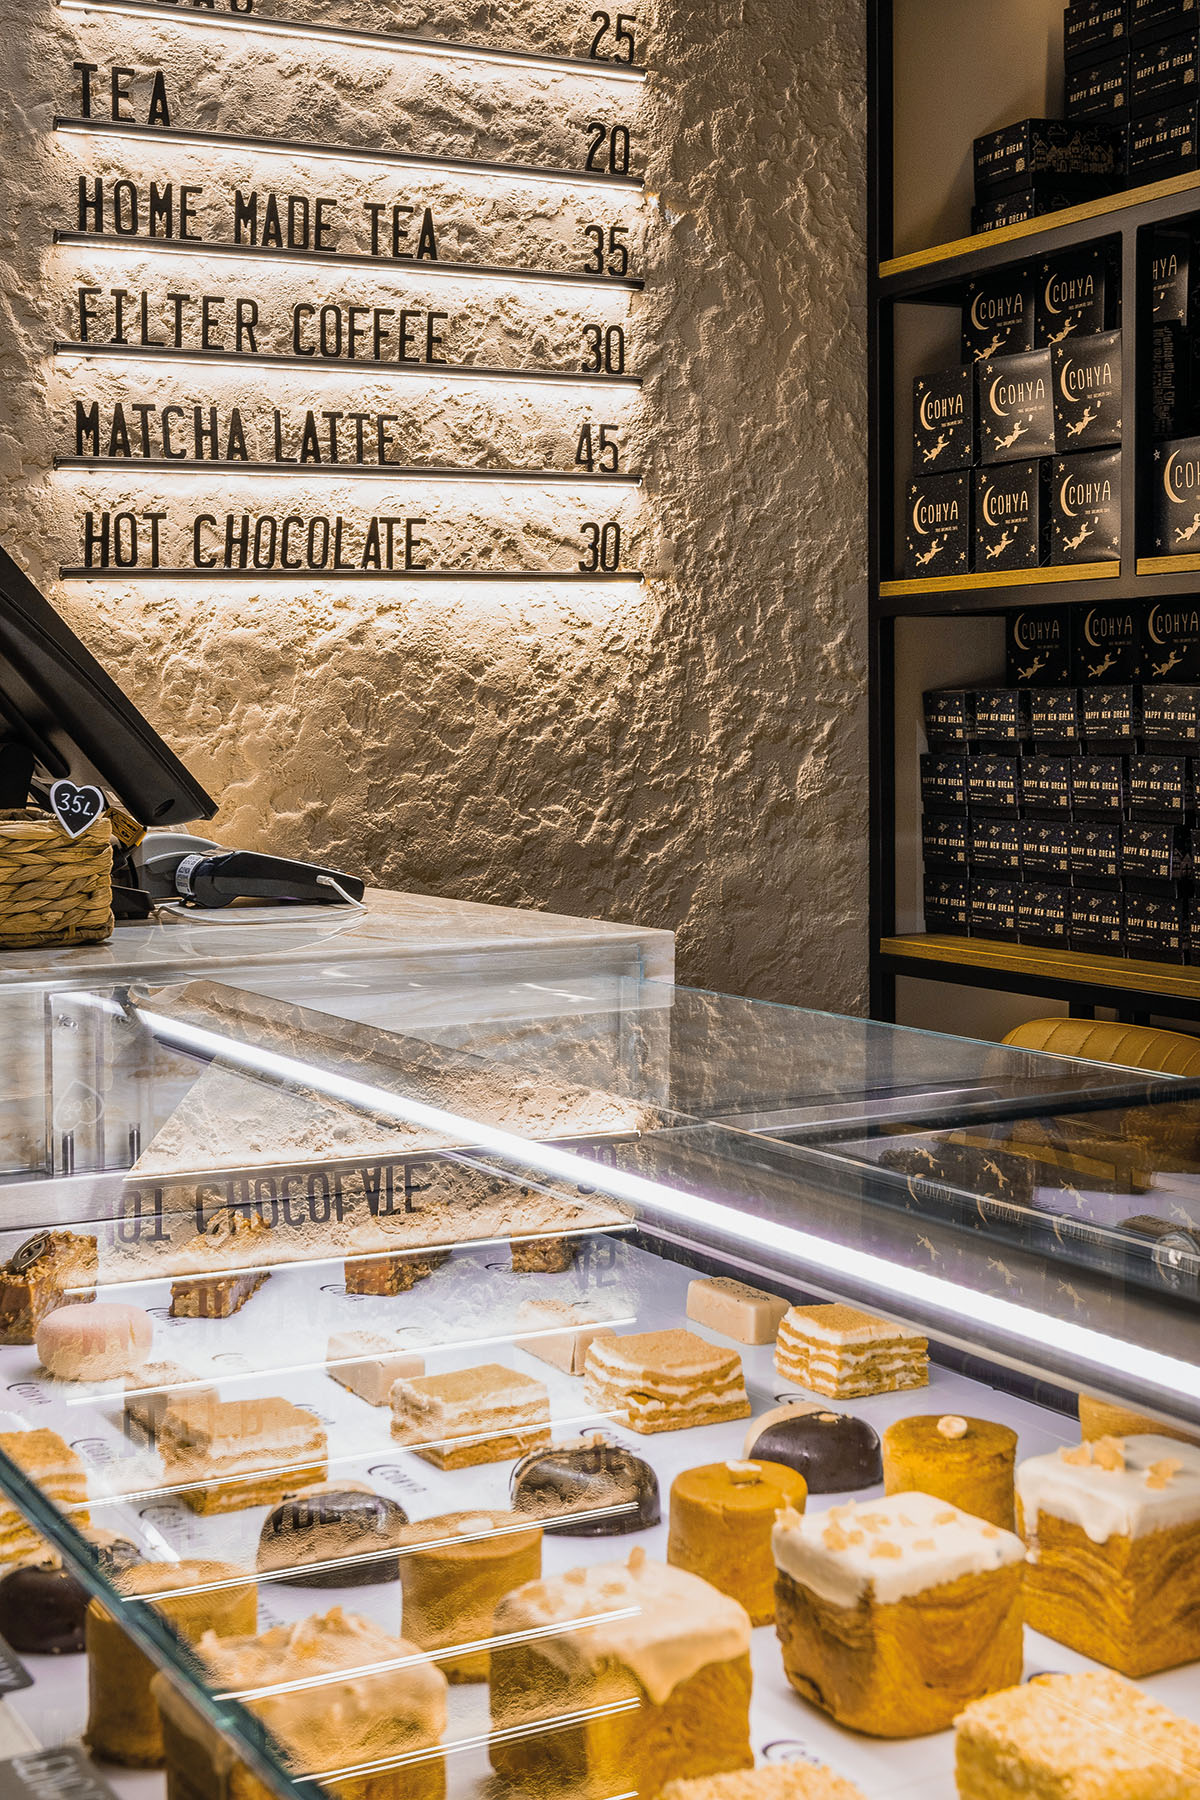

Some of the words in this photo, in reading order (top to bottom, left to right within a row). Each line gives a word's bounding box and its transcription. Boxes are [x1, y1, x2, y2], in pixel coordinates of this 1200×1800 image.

[1068, 20, 1086, 35] HAPPY
[1088, 15, 1100, 27] NEW
[1102, 7, 1121, 21] DREAM
[590, 10, 636, 64] 25
[1137, 65, 1154, 80] HAPPY
[1157, 60, 1170, 72] NEW
[1172, 52, 1193, 67] DREAM
[73, 62, 170, 126] TEA
[1070, 89, 1087, 103] HAPPY
[1090, 84, 1101, 96] NEW
[1103, 77, 1122, 91] DREAM
[585, 123, 631, 176] 20
[1134, 136, 1153, 150] HAPPY
[1155, 131, 1168, 143] NEW
[1170, 124, 1191, 139] DREAM
[978, 153, 993, 167] HAPPY
[994, 148, 1004, 160] NEW
[1006, 142, 1024, 156] DREAM
[78, 177, 203, 241] HOME
[235, 191, 338, 252] MADE
[364, 203, 439, 260] TEA
[995, 217, 1006, 228] NEW
[1009, 211, 1028, 224] DREAM
[584, 225, 630, 276] 35
[1152, 254, 1178, 280] HYA
[1052, 274, 1094, 303] COHYA
[980, 293, 1023, 320] COHYA
[78, 288, 258, 353] FILTER
[293, 303, 449, 364] COFFEE
[581, 324, 625, 375] 30
[1069, 362, 1112, 390] COHYA
[1000, 378, 1045, 405] COHYA
[927, 394, 963, 420] COHYA
[76, 401, 248, 462] MATCHA
[273, 410, 399, 466] LATTE
[575, 424, 619, 473] 45
[1175, 461, 1200, 488] COH
[990, 490, 1029, 515] COHYA
[1069, 480, 1111, 506] COHYA
[920, 500, 959, 524] COHYA
[85, 512, 167, 569] HOT
[193, 513, 427, 571] CHOCOLATE
[579, 522, 621, 573] 30
[1022, 620, 1060, 640] COHYA
[1092, 615, 1134, 637] COHYA
[1156, 610, 1198, 635] COHYA
[938, 715, 946, 723] NEW
[948, 715, 963, 724] DREAM
[976, 712, 988, 721] HAPPY
[990, 713, 999, 722] NEW
[1000, 713, 1015, 722] DREAM
[1032, 713, 1046, 721] HAPPY
[1047, 713, 1057, 721] NEW
[1058, 712, 1074, 721] DREAM
[1085, 711, 1099, 720] HAPPY
[1101, 710, 1111, 720] NEW
[1112, 710, 1130, 719] DREAM
[1144, 710, 1161, 720] HAPPY
[1163, 711, 1175, 720] NEW
[1177, 712, 1196, 721] DREAM
[937, 777, 946, 786] NEW
[948, 778, 963, 786] DREAM
[970, 779, 984, 788] HAPPY
[986, 780, 996, 788] NEW
[997, 780, 1014, 789] DREAM
[1024, 780, 1038, 788] HAPPY
[1039, 780, 1050, 790] NEW
[1050, 781, 1067, 790] DREAM
[1073, 780, 1088, 789] HAPPY
[1090, 781, 1100, 790] NEW
[1101, 782, 1118, 791] DREAM
[1131, 780, 1147, 789] HAPPY
[1149, 780, 1160, 790] NEW
[1162, 782, 1181, 792] DREAM
[938, 838, 948, 846] NEW
[949, 838, 965, 848] DREAM
[974, 840, 988, 849] HAPPY
[989, 842, 1000, 850] NEW
[1001, 842, 1018, 851] DREAM
[1023, 844, 1038, 852] HAPPY
[1039, 845, 1050, 854] NEW
[1050, 846, 1068, 855] DREAM
[1070, 846, 1085, 856] HAPPY
[1086, 848, 1097, 857] NEW
[1098, 849, 1116, 859] DREAM
[1123, 846, 1138, 855] HAPPY
[1139, 848, 1150, 857] NEW
[1151, 849, 1170, 860] DREAM
[940, 897, 949, 905] NEW
[950, 898, 966, 907] DREAM
[972, 901, 985, 910] HAPPY
[998, 904, 1014, 912] DREAM
[1018, 906, 1032, 915] HAPPY
[1034, 908, 1044, 916] NEW
[1046, 909, 1064, 918] DREAM
[1072, 912, 1087, 921] HAPPY
[1088, 913, 1100, 923] NEW
[1102, 914, 1120, 924] DREAM
[1128, 917, 1144, 926] HAPPY
[1146, 920, 1158, 928] NEW
[1160, 921, 1179, 931] DREAM
